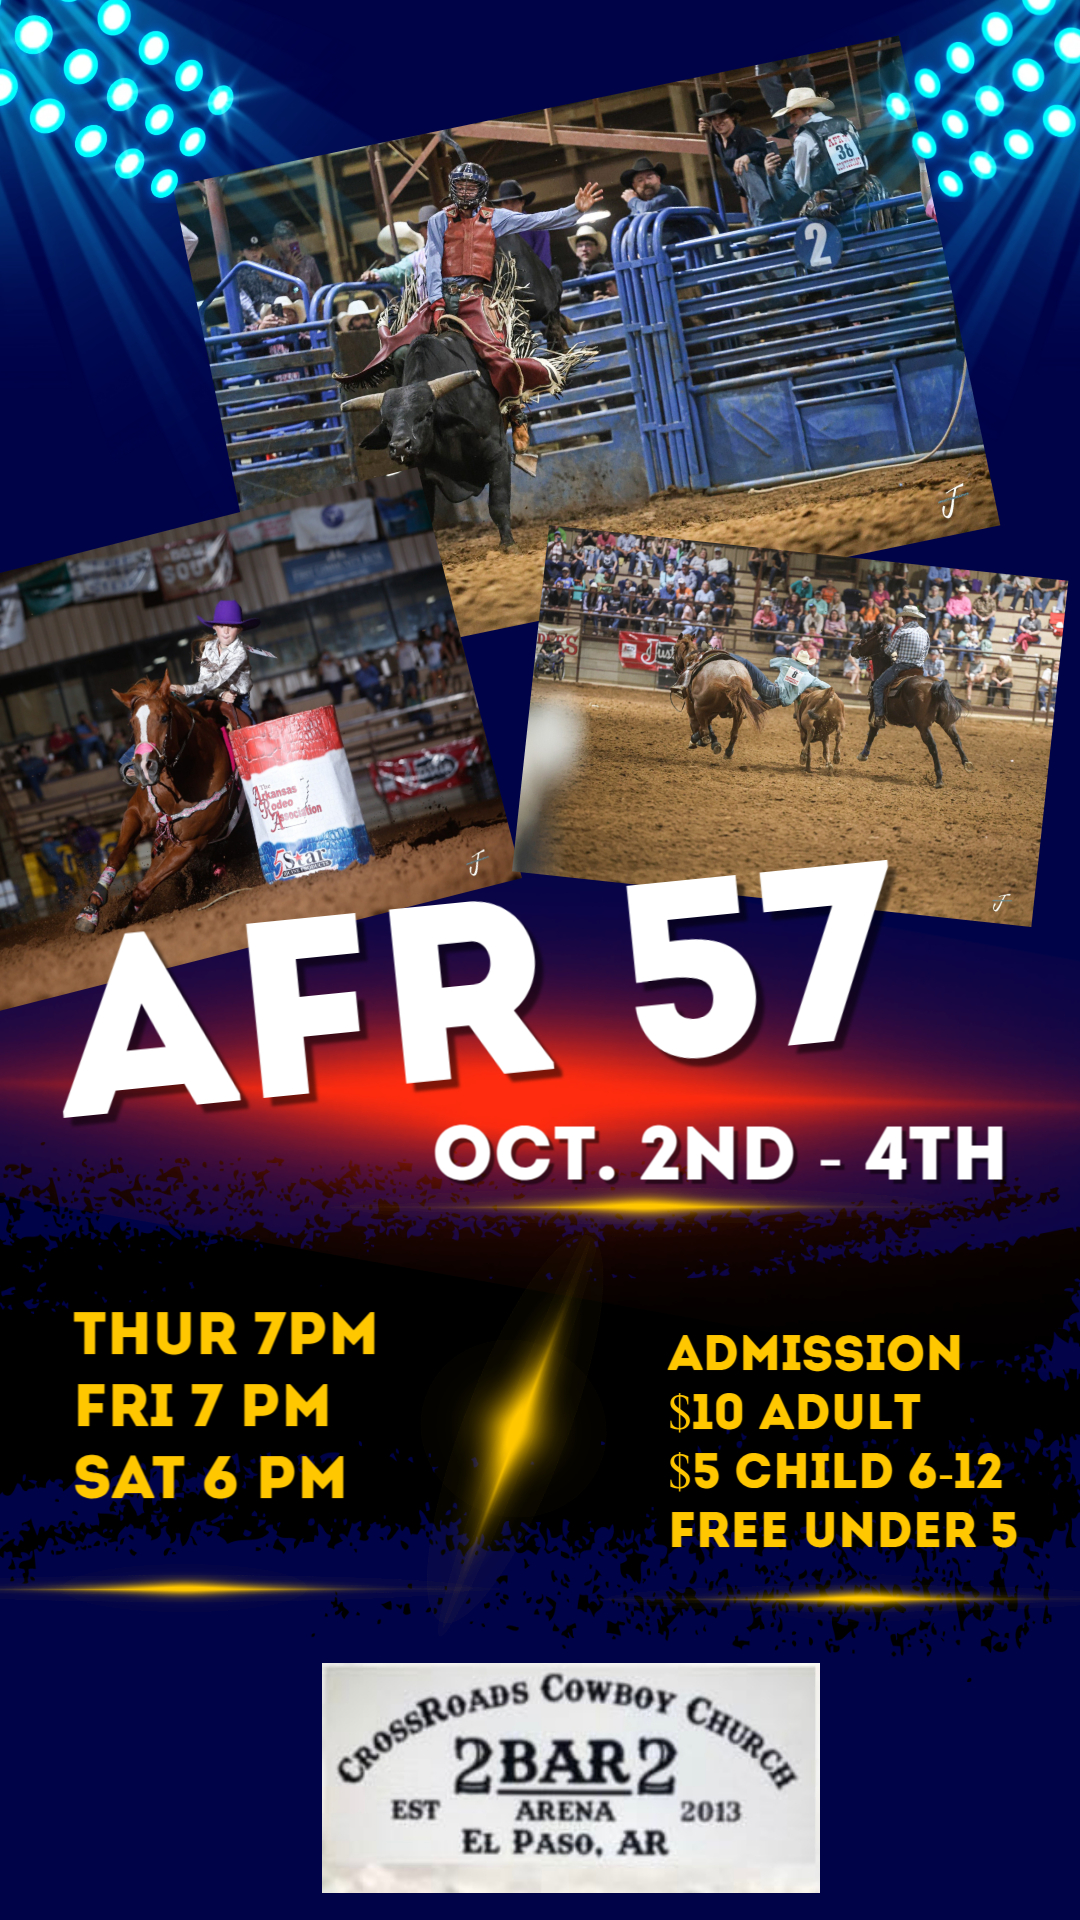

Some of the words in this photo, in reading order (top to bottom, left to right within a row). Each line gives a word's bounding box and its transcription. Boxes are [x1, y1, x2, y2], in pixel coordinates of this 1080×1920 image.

[804, 222, 832, 267] 2
[252, 785, 297, 806] Arkansas
[259, 799, 293, 820] Rodeo
[271, 804, 322, 832] Association
[391, 1800, 441, 1820] EST
[516, 1801, 615, 1821] ARENA
[681, 1802, 741, 1822] 2013
[618, 1830, 669, 1855] AR
